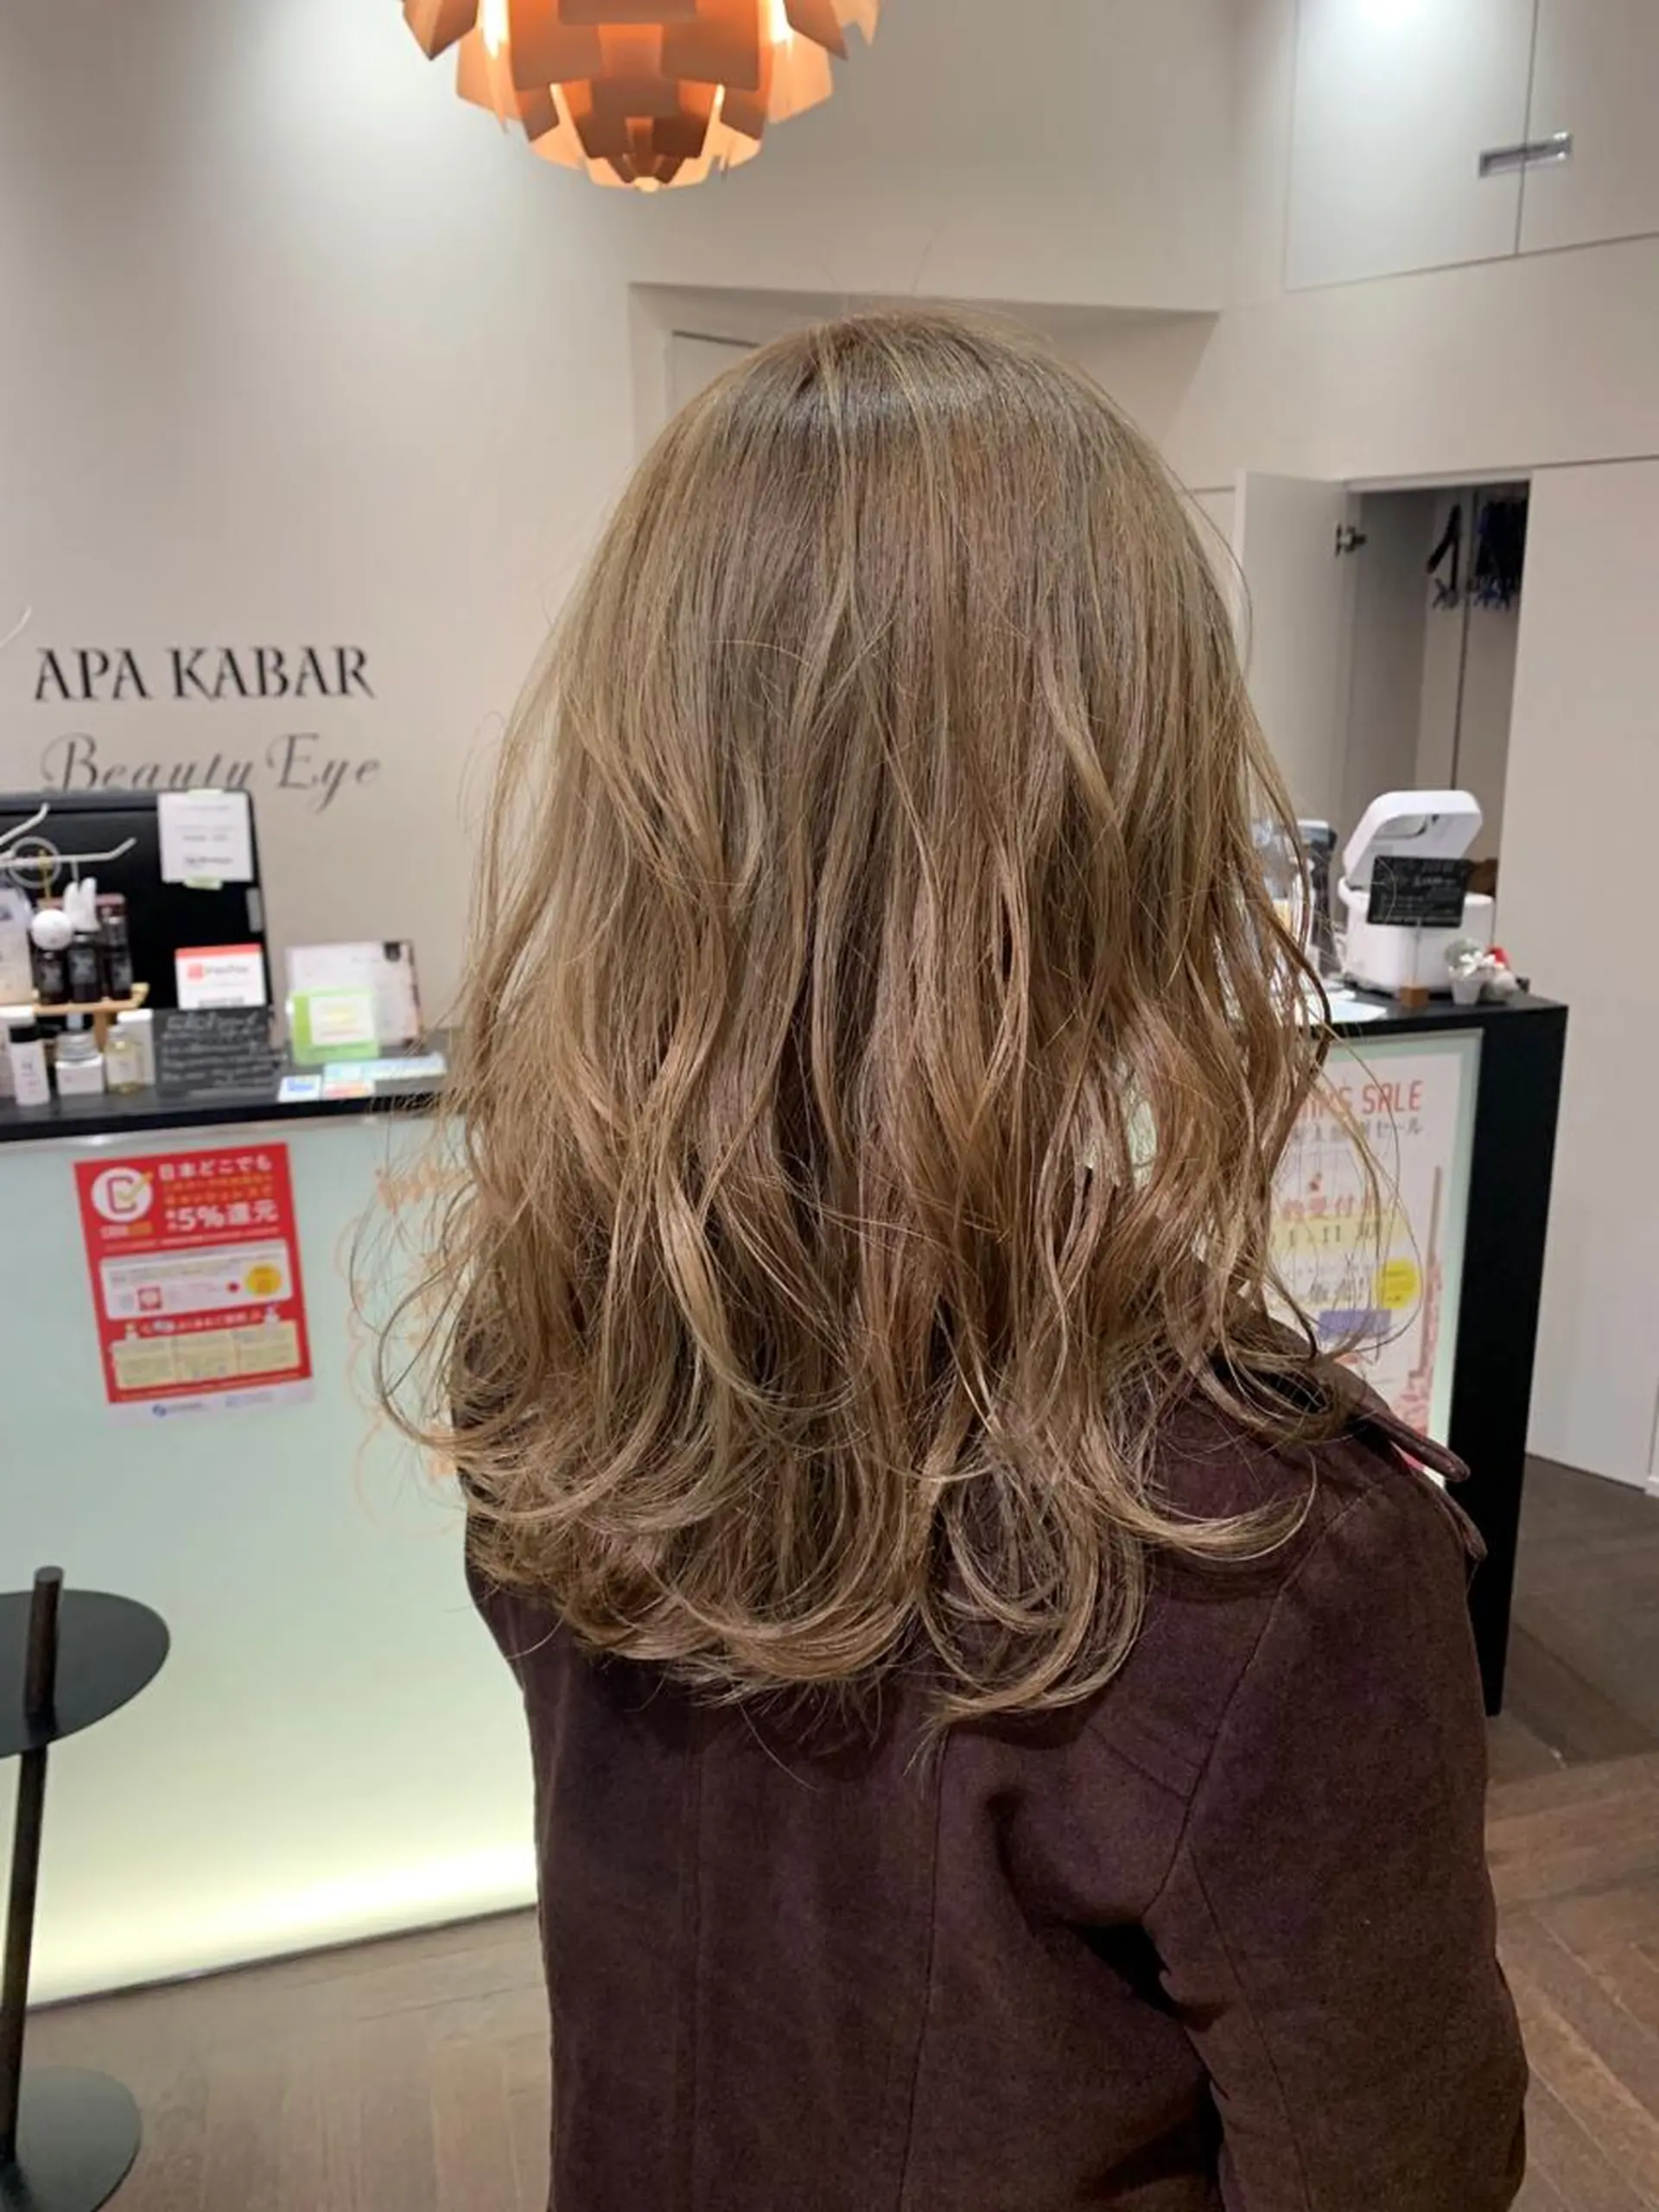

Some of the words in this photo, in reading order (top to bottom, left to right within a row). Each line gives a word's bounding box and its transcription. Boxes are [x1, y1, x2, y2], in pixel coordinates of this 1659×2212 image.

[35, 647, 150, 701] APA
[168, 645, 374, 700] KABAR
[265, 732, 381, 813] Eye
[1362, 1080, 1423, 1115] SALE
